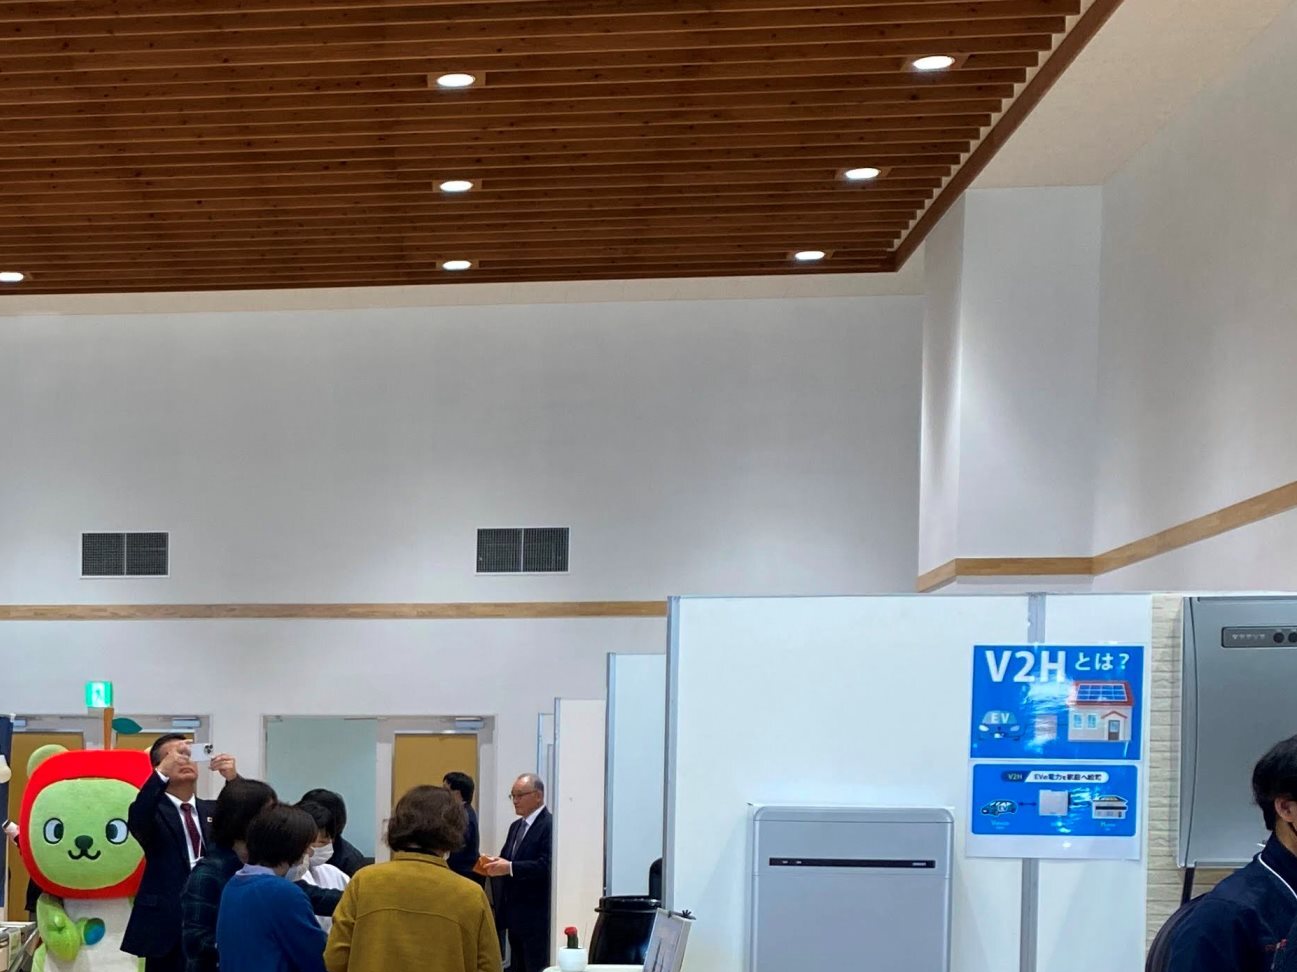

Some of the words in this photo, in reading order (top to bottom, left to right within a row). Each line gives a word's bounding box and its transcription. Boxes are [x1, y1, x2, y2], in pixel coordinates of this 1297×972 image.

[984, 650, 1067, 683] V2H
[1074, 652, 1131, 671] とは？
[990, 712, 1010, 725] EV
